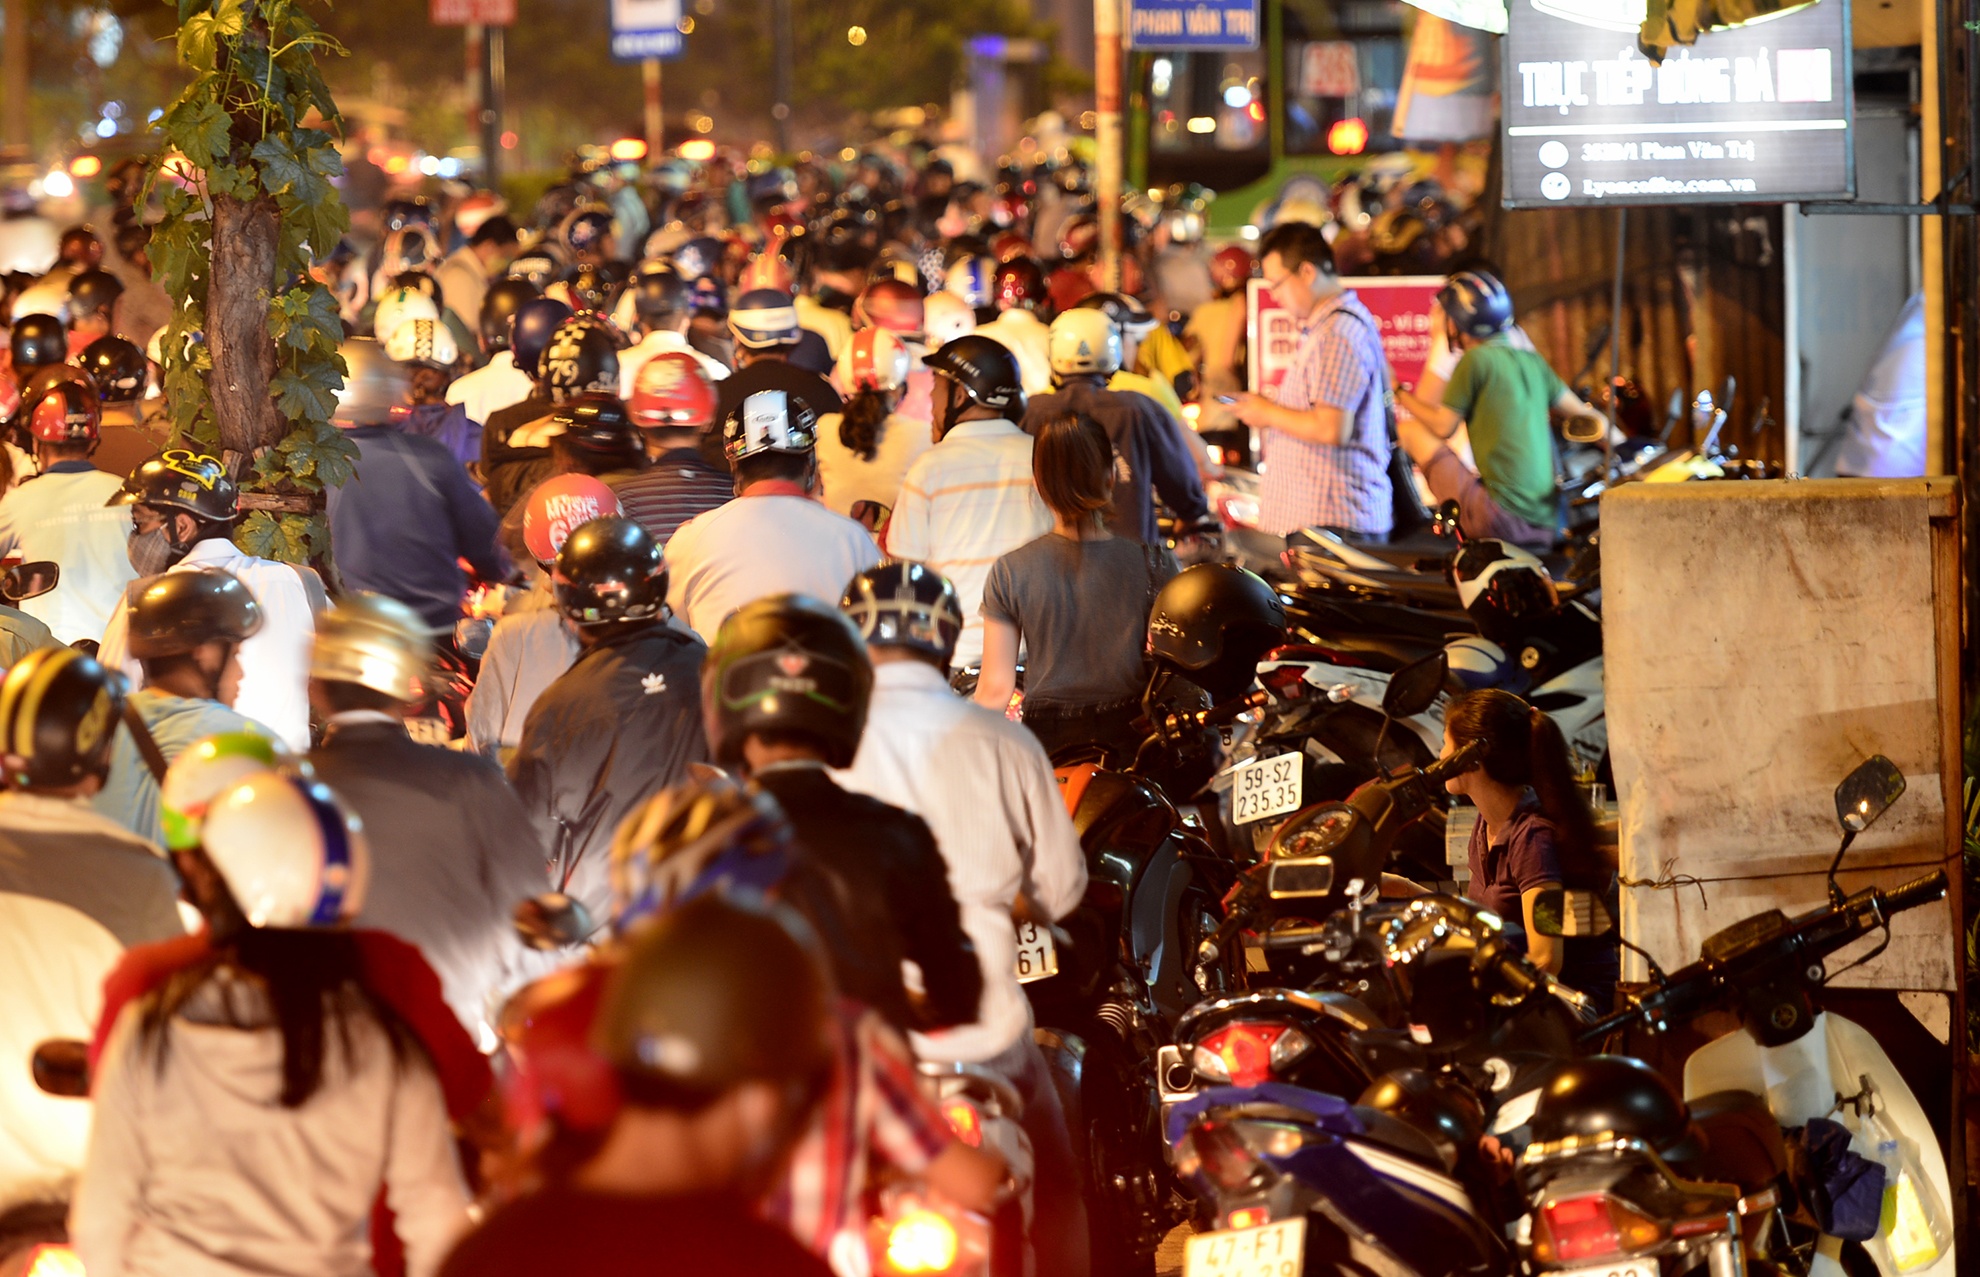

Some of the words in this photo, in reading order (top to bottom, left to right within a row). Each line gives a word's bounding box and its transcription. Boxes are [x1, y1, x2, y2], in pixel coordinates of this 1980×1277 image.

[548, 360, 580, 386] 79
[1245, 760, 1291, 791] 59-S2
[1239, 783, 1297, 818] 235.35
